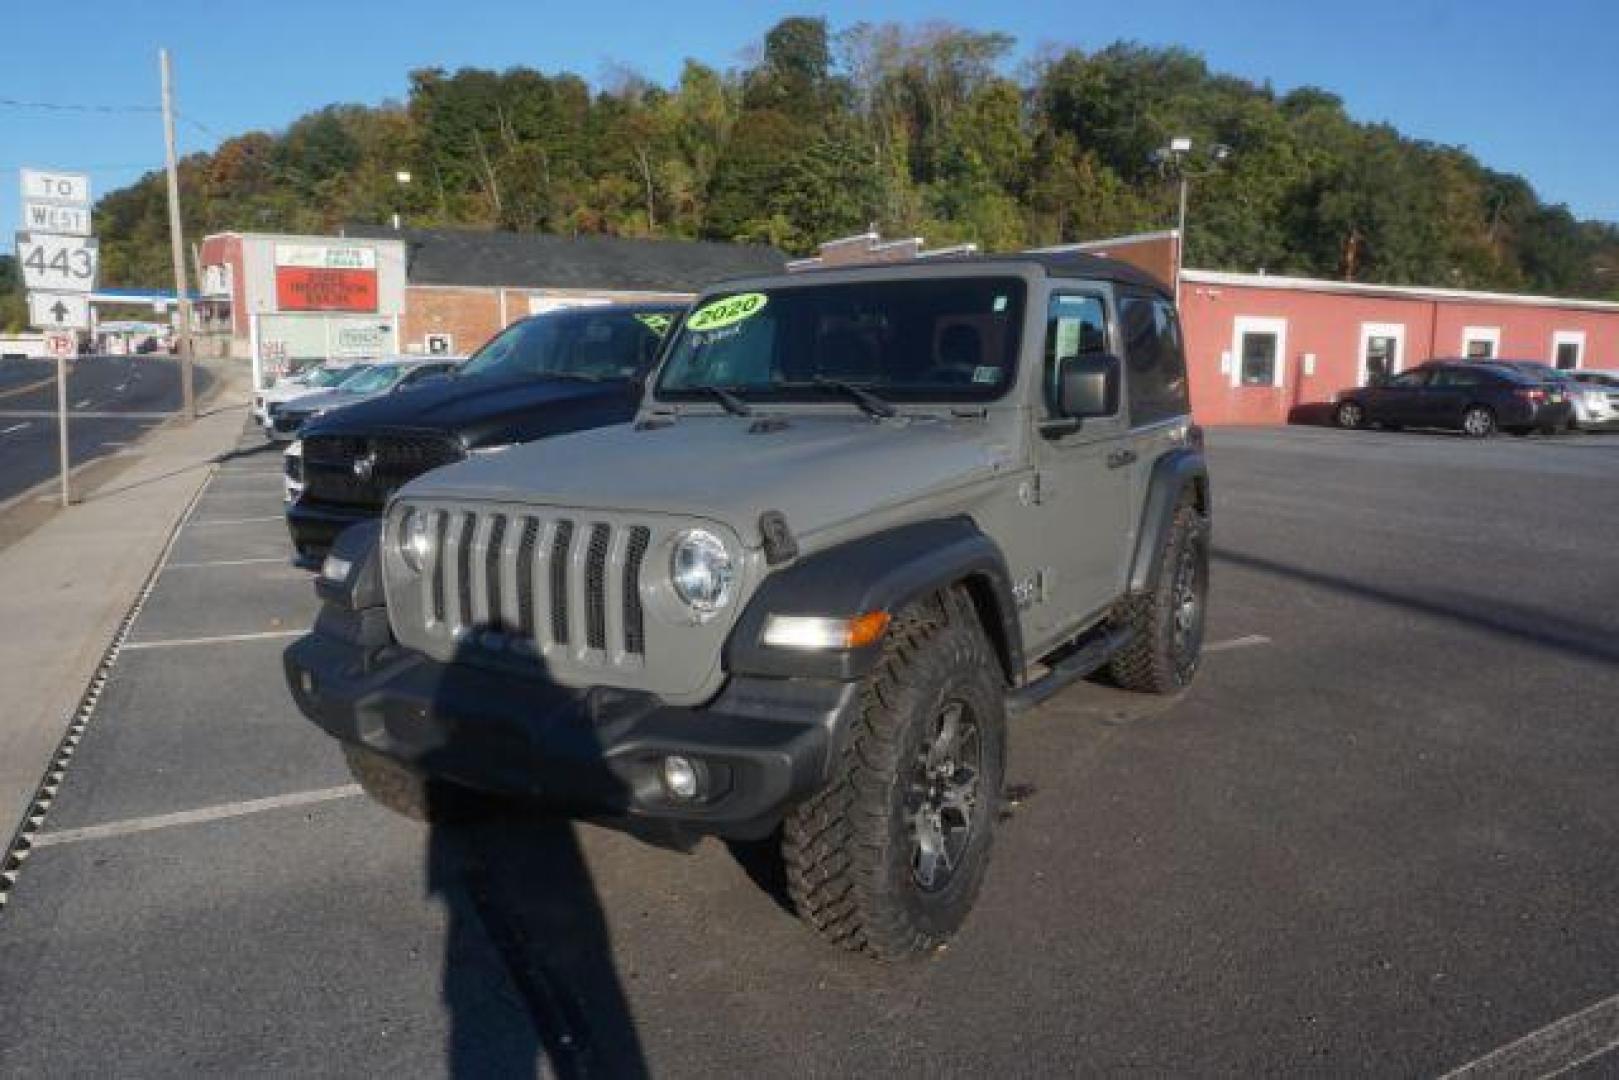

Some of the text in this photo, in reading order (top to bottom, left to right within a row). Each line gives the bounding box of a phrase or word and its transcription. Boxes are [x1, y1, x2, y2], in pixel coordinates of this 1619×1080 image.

[42, 178, 72, 195] TO
[32, 206, 81, 231] WEST
[24, 245, 92, 279] 443
[695, 295, 760, 327] 2020
